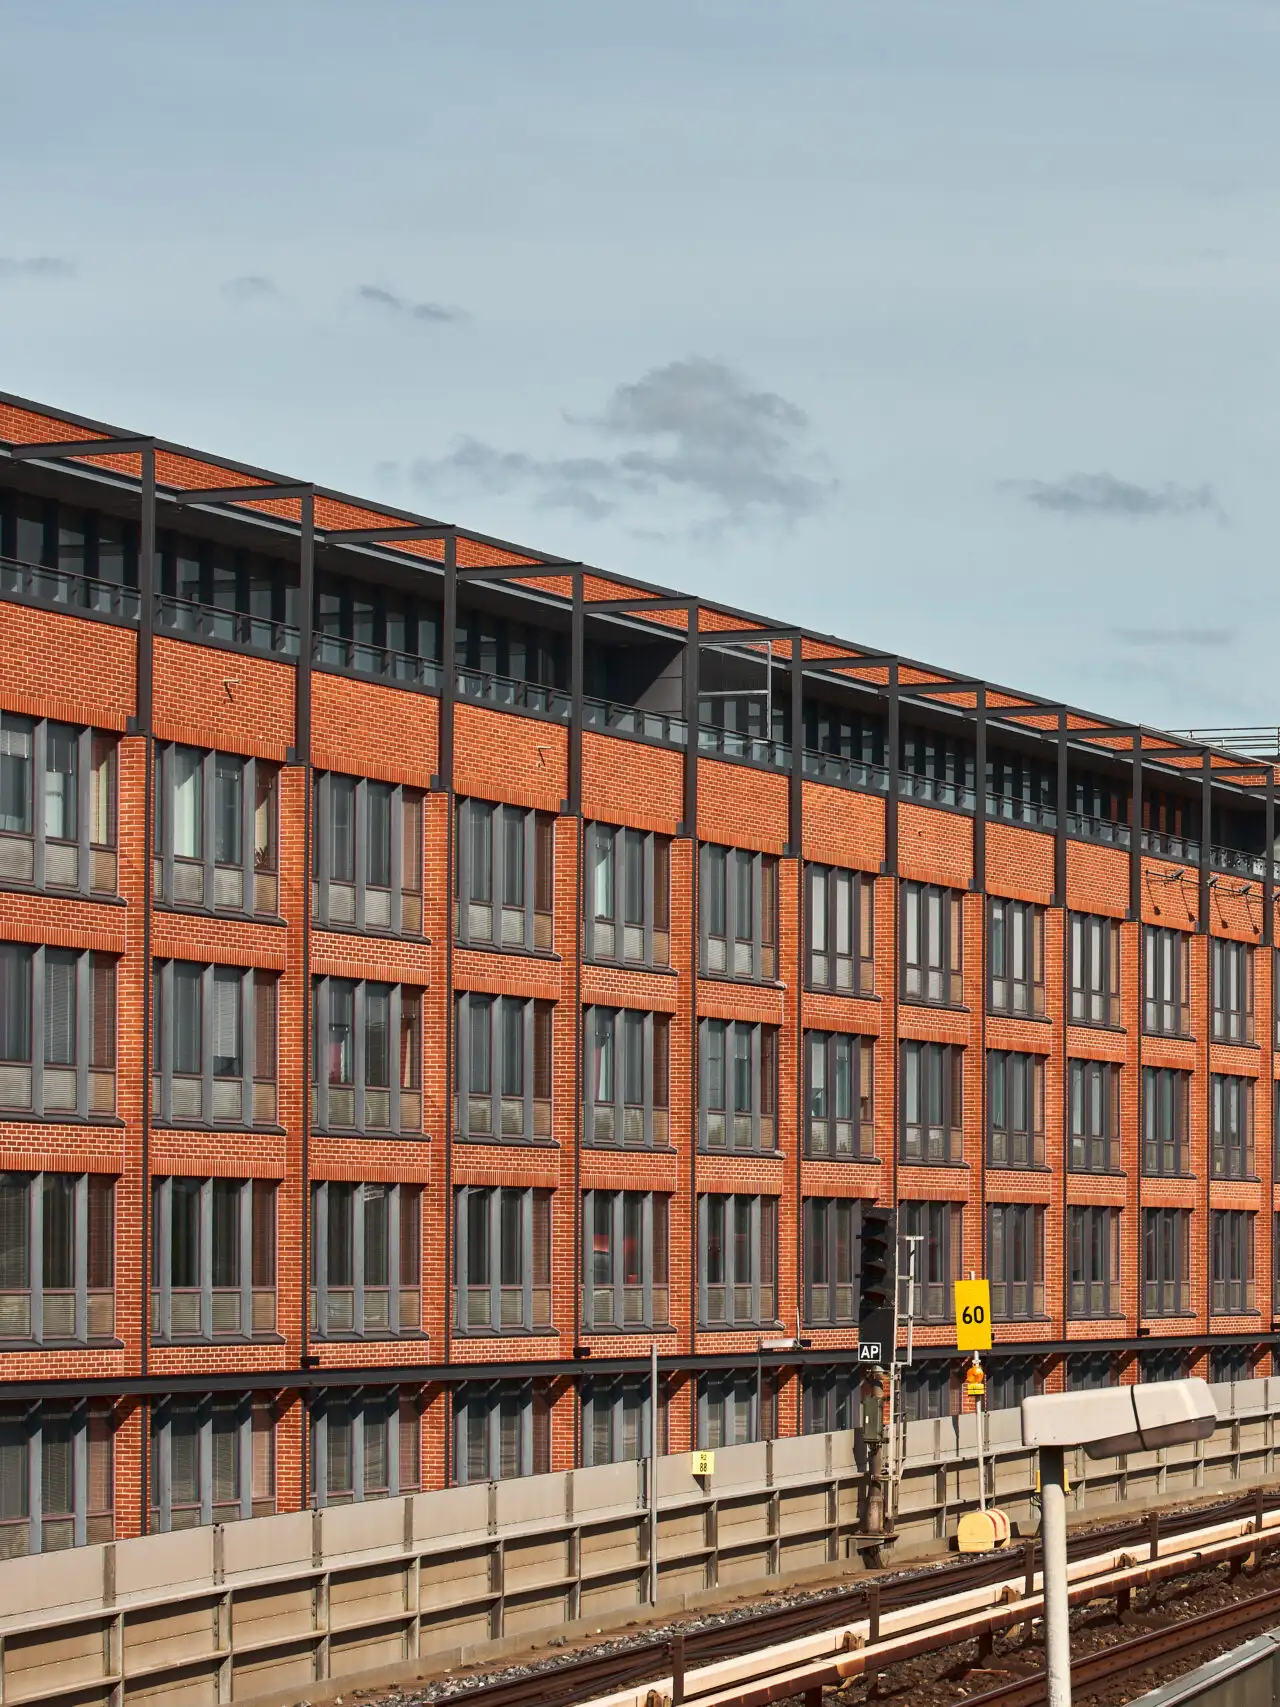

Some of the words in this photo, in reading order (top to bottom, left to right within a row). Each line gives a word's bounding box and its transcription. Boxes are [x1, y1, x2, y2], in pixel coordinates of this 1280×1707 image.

[962, 1305, 984, 1324] 60
[860, 1345, 879, 1358] AP
[699, 1462, 708, 1472] 88
